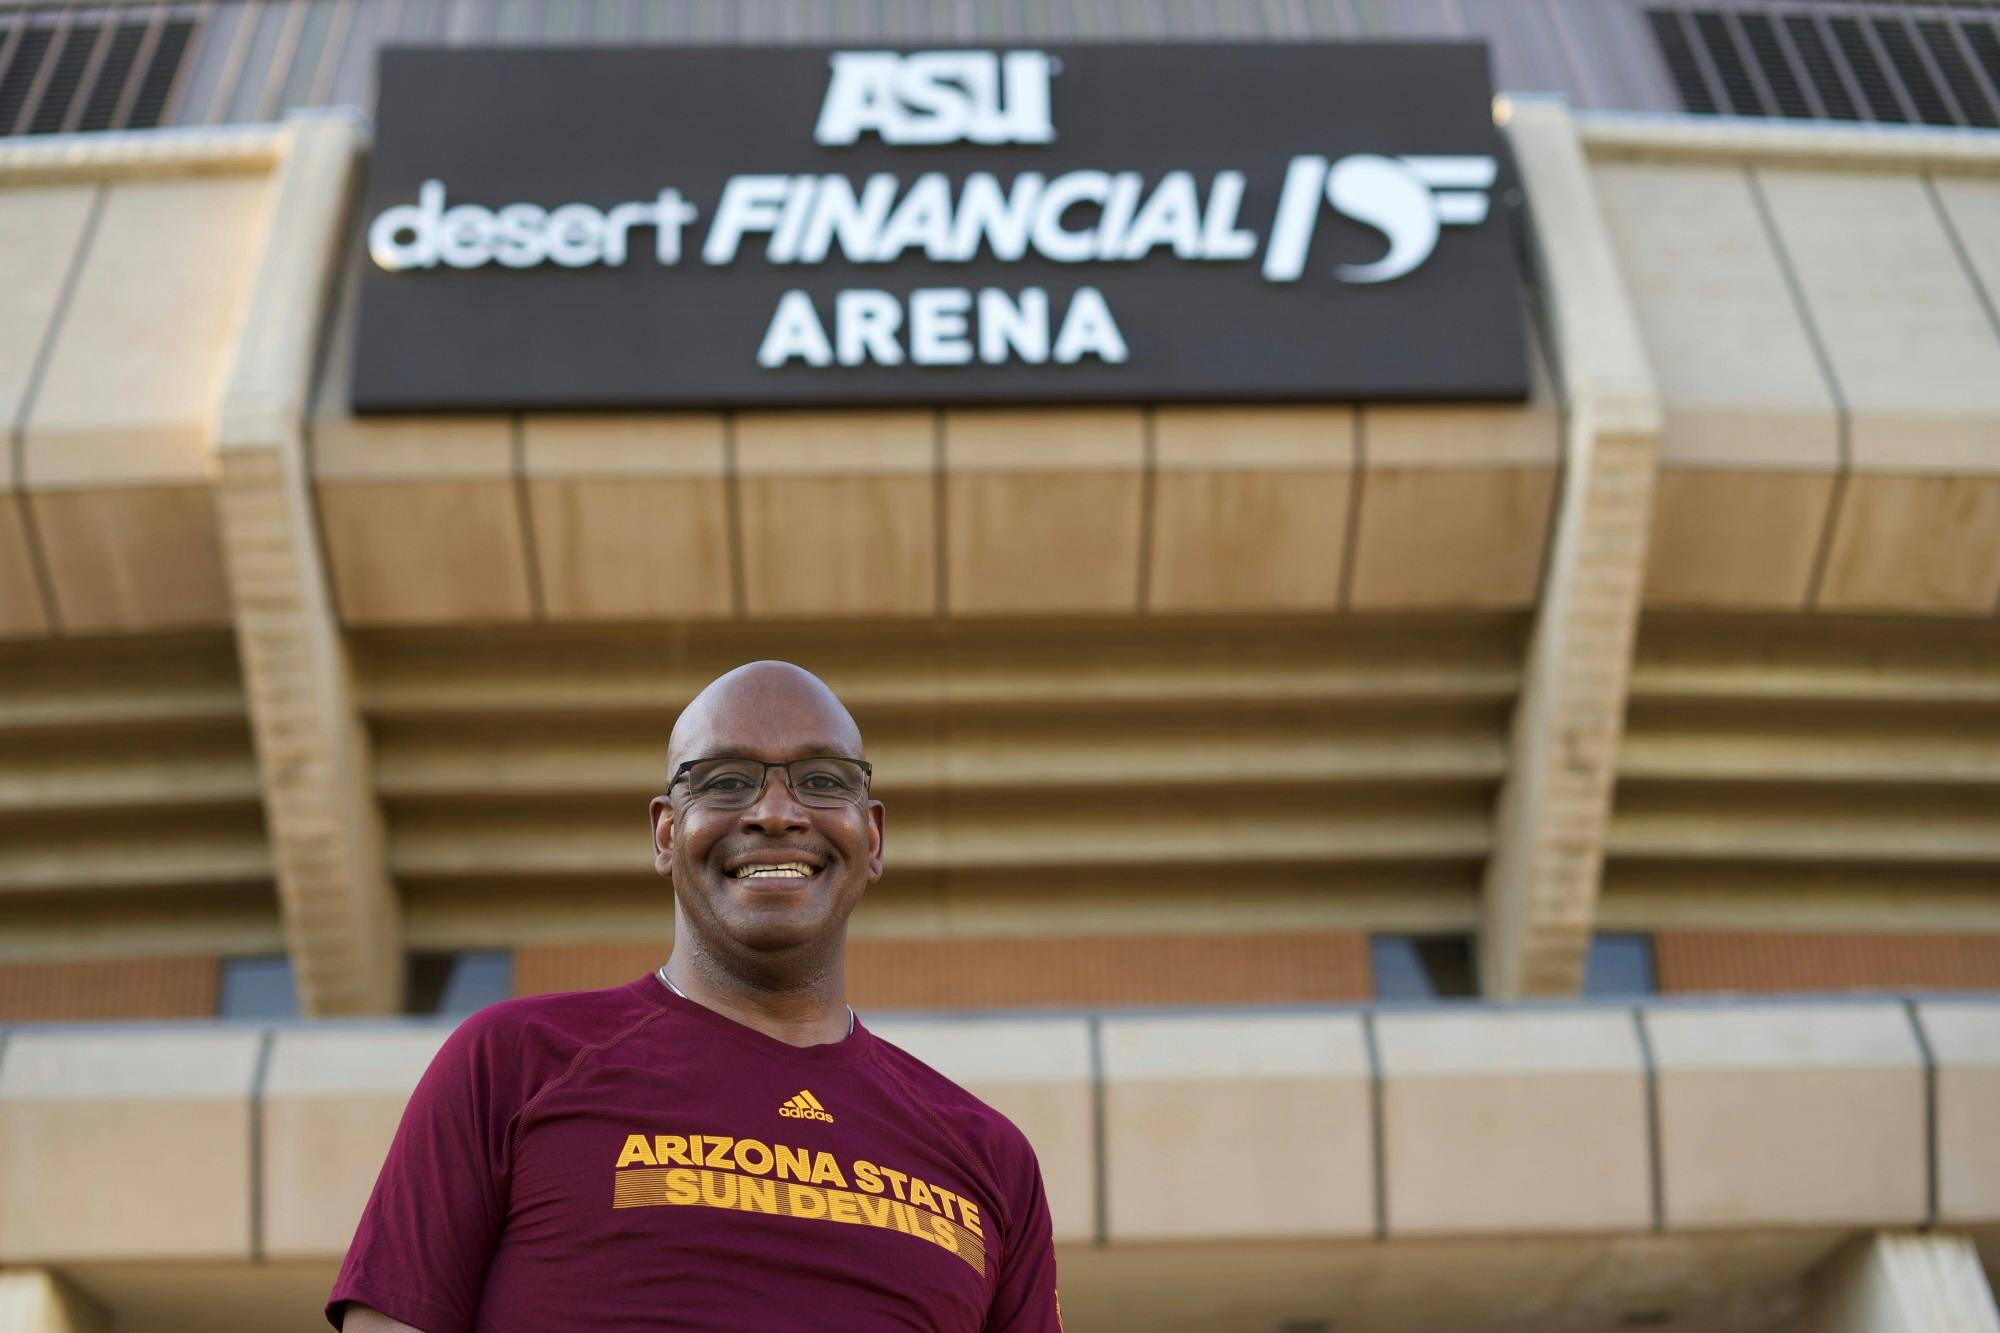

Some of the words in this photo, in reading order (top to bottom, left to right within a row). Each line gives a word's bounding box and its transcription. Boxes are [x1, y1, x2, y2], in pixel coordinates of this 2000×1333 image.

[814, 51, 1056, 145] ASU
[368, 180, 697, 270] desert
[703, 173, 1257, 264] FINANCIAL
[758, 288, 1129, 367] ARENA
[778, 1106, 834, 1123] adidas
[615, 1134, 848, 1188] ARIZONA
[852, 1160, 983, 1235] STATE
[665, 1169, 776, 1215] SUN
[788, 1187, 960, 1254] DEVILS
